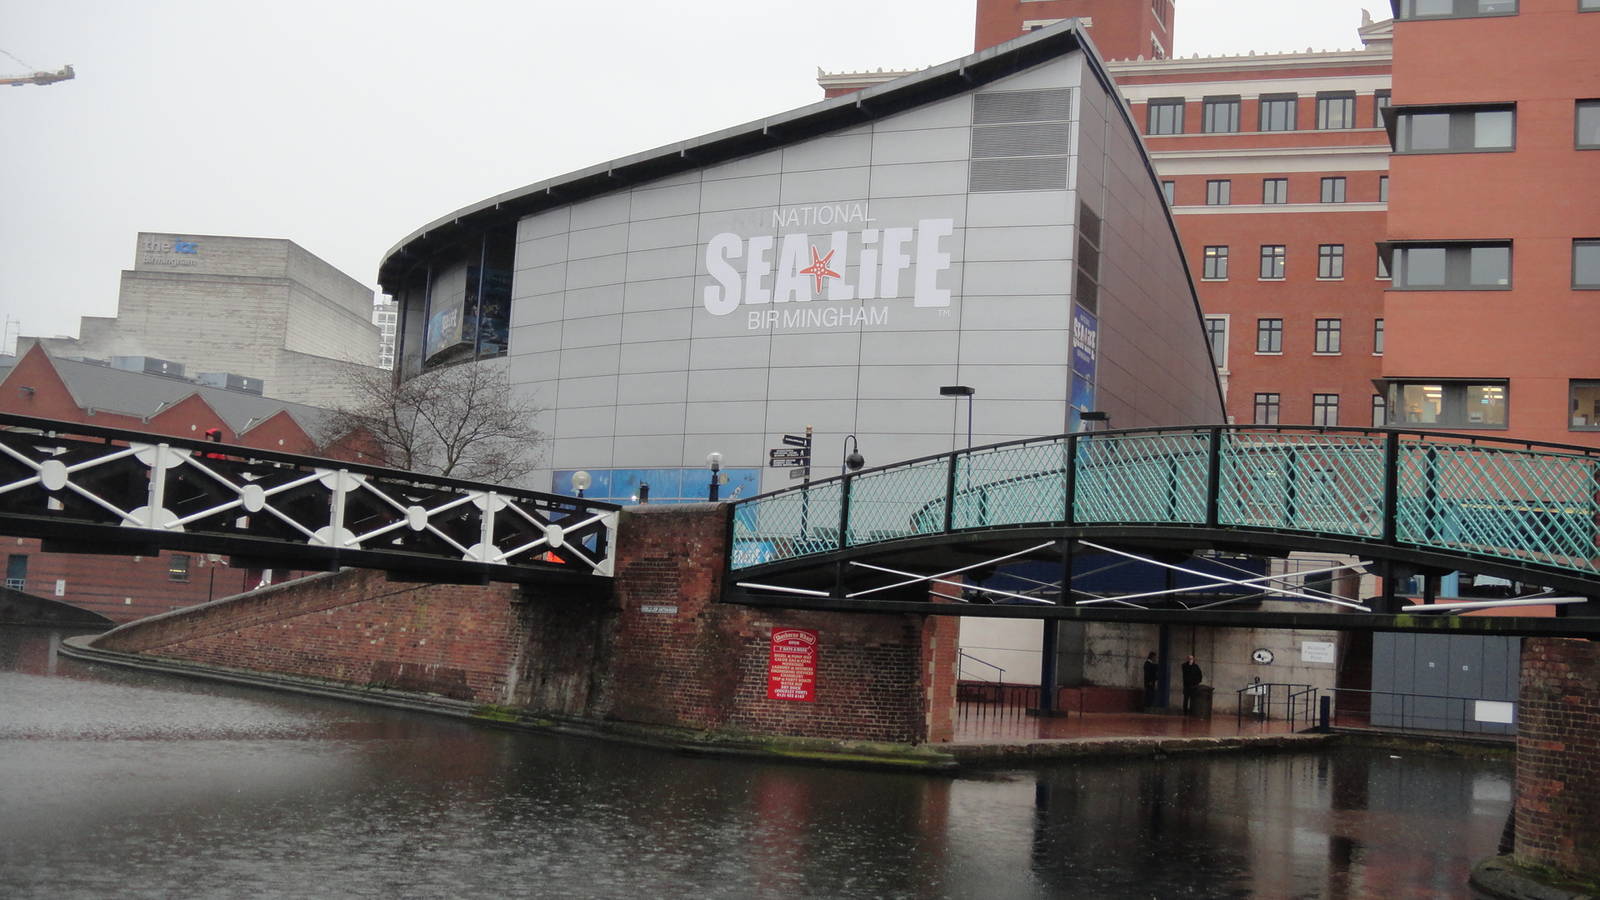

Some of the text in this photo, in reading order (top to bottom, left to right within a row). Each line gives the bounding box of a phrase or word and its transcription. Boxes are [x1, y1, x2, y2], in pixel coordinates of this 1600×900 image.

[771, 203, 877, 229] NATIONAL
[703, 232, 812, 316] SEA
[747, 306, 889, 331] BIRMINGHAM
